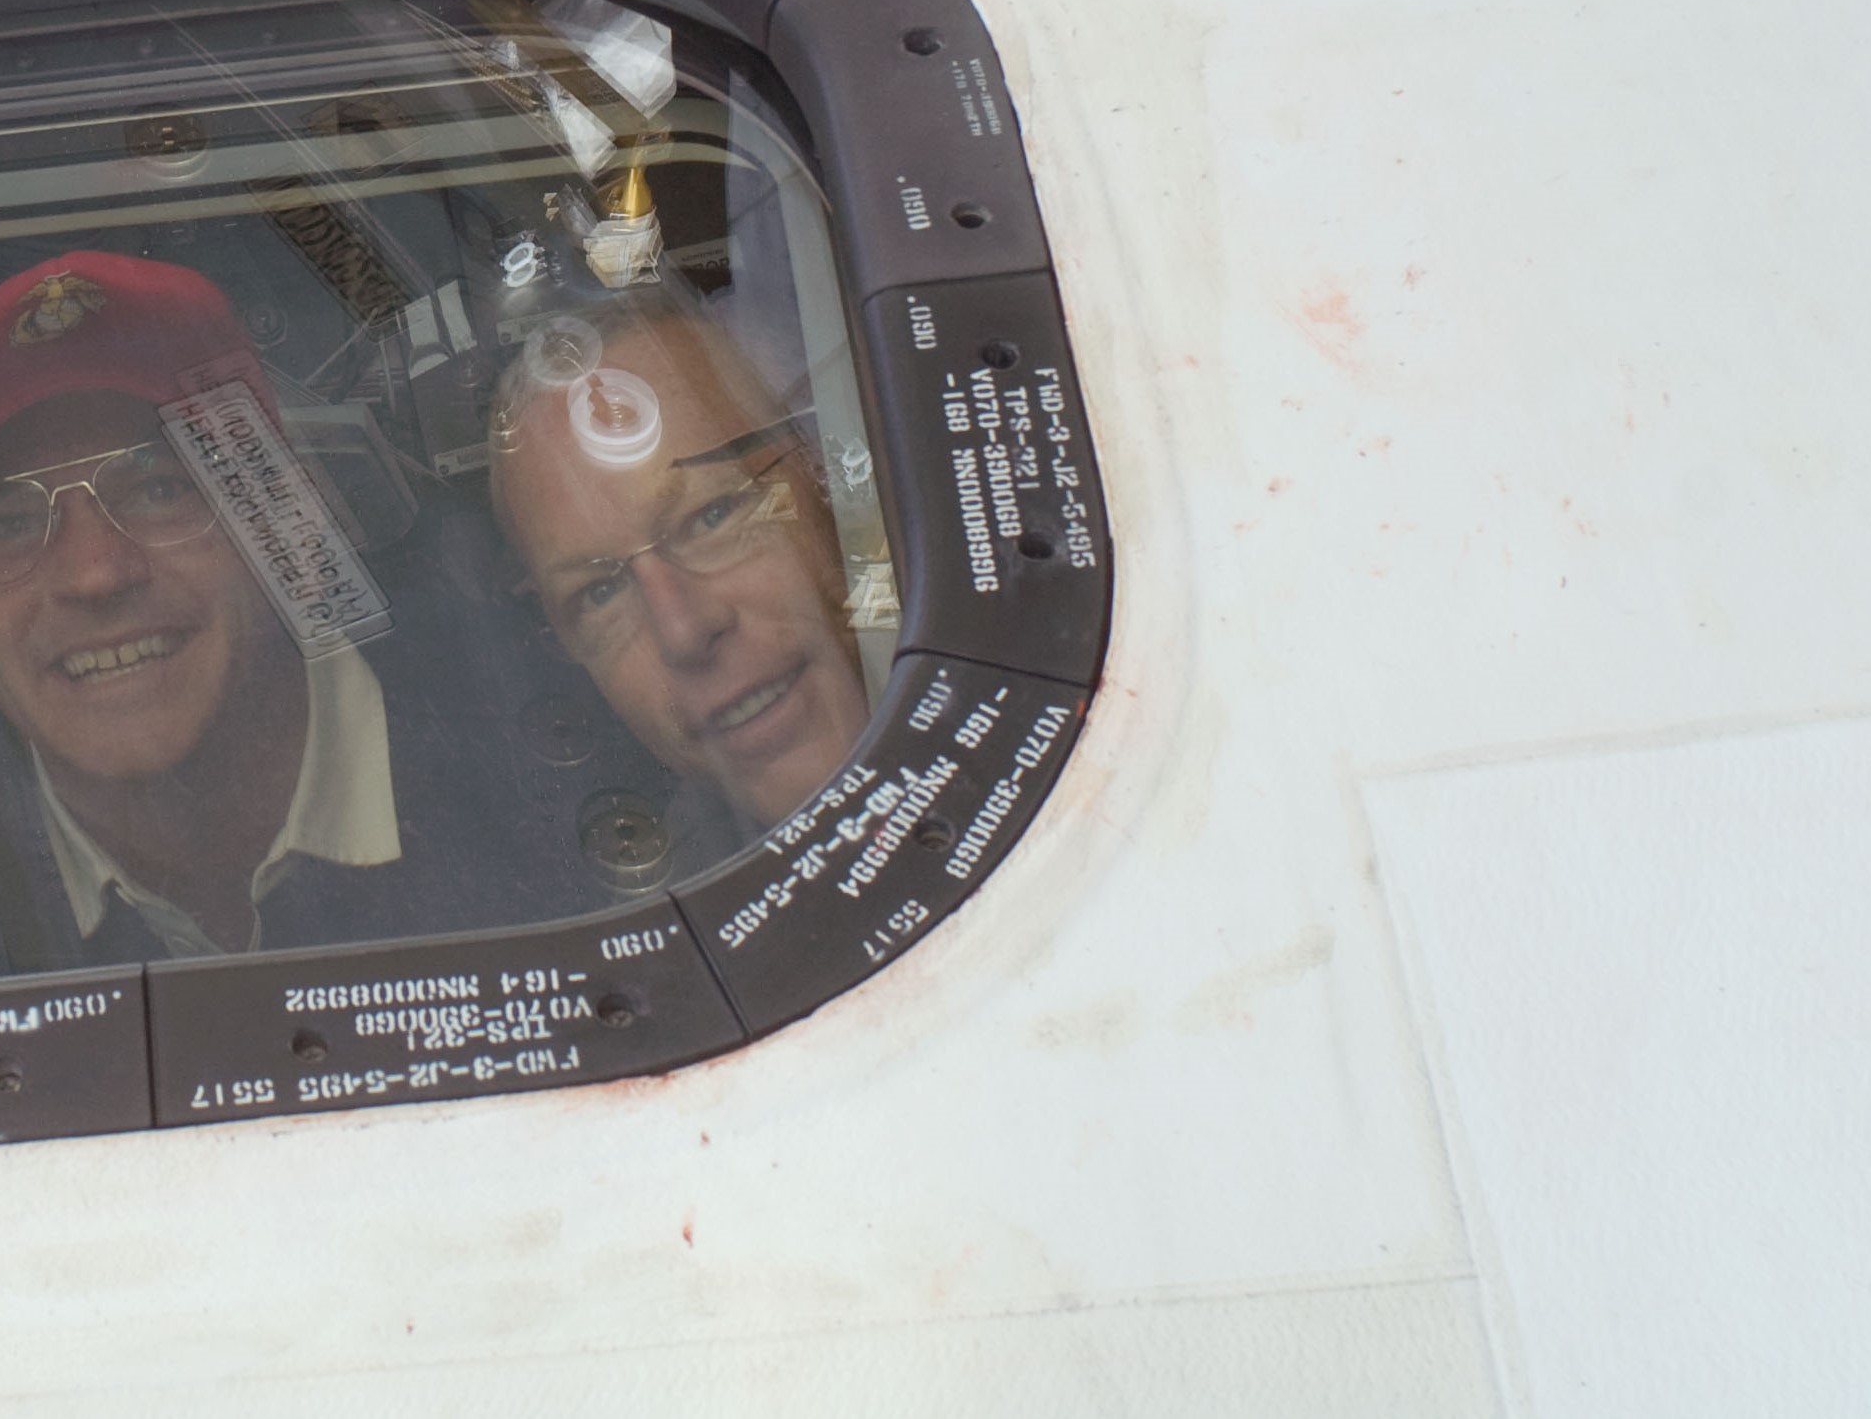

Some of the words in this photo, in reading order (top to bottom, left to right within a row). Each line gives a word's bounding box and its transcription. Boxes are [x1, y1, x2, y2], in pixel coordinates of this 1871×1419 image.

[895, 174, 933, 231] .090
[906, 295, 938, 351] .090
[941, 372, 972, 433] -168
[969, 367, 1023, 539] V070-390068
[1003, 385, 1041, 490] TPS-321
[1033, 366, 1098, 569] FWD-3-J2-5495
[950, 446, 1000, 593] MN0008996
[908, 668, 953, 732] .090
[953, 686, 1009, 749] -166
[764, 763, 878, 856] TPS-321
[944, 704, 1072, 880] V070-390068
[718, 766, 921, 948] FWD-3-J2-5495
[837, 754, 960, 898] MN0008994
[600, 924, 680, 961] .090
[861, 898, 930, 962] 5517
[41, 989, 123, 1022] .090
[284, 976, 481, 1013] MN0008992
[500, 969, 588, 995] -164
[354, 994, 593, 1036] V070-390068
[406, 1014, 553, 1053] TPS-321
[190, 1078, 276, 1110] 5517
[298, 1045, 581, 1103] FWD-3-J2-5495
